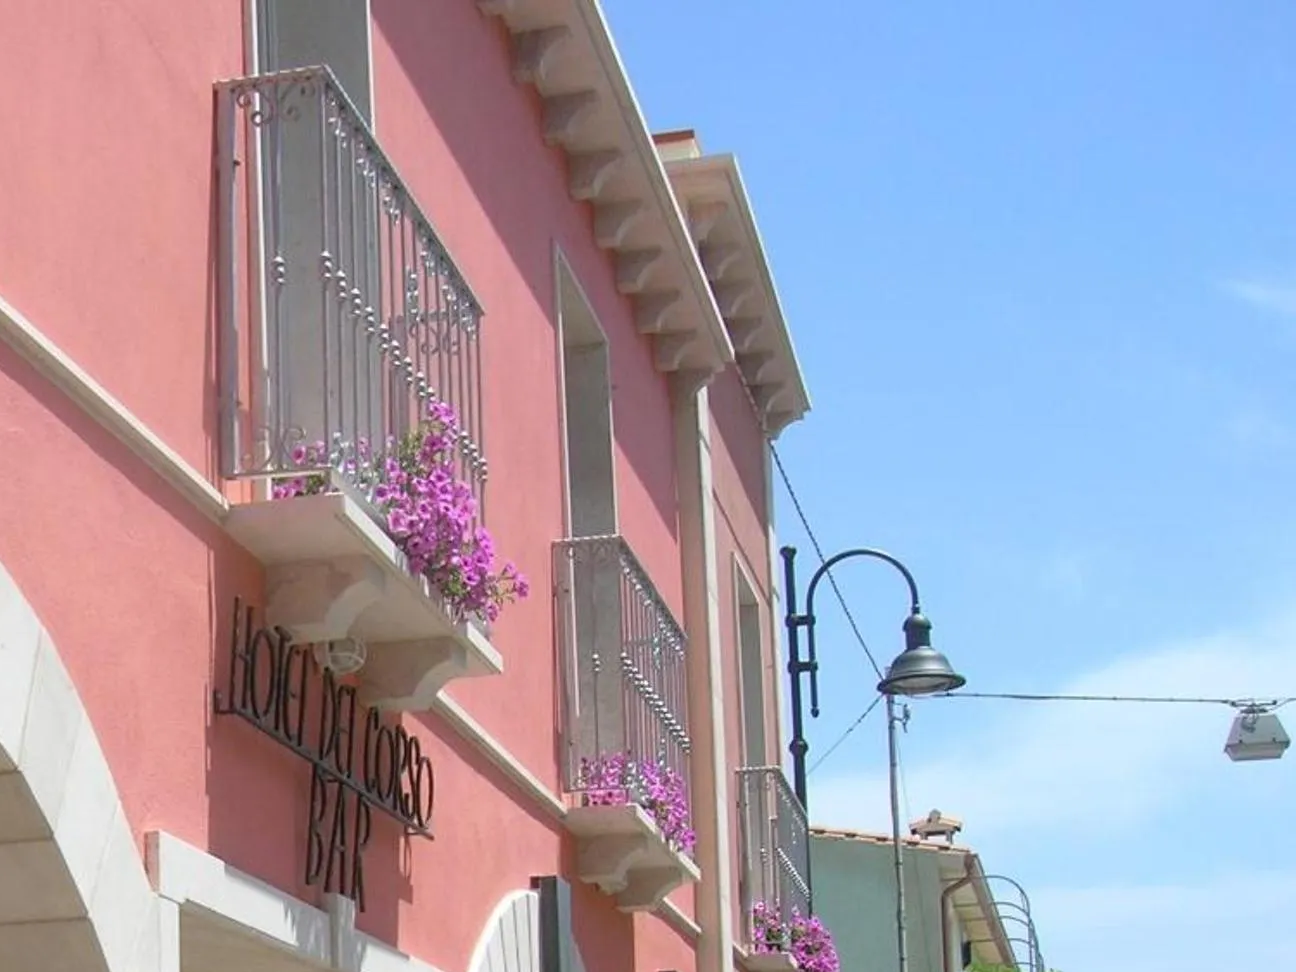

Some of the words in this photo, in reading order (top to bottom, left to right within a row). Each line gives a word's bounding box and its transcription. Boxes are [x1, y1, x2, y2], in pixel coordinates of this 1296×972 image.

[229, 596, 310, 751] HOTEL
[363, 706, 435, 830] CORSO
[306, 764, 370, 913] BAR
